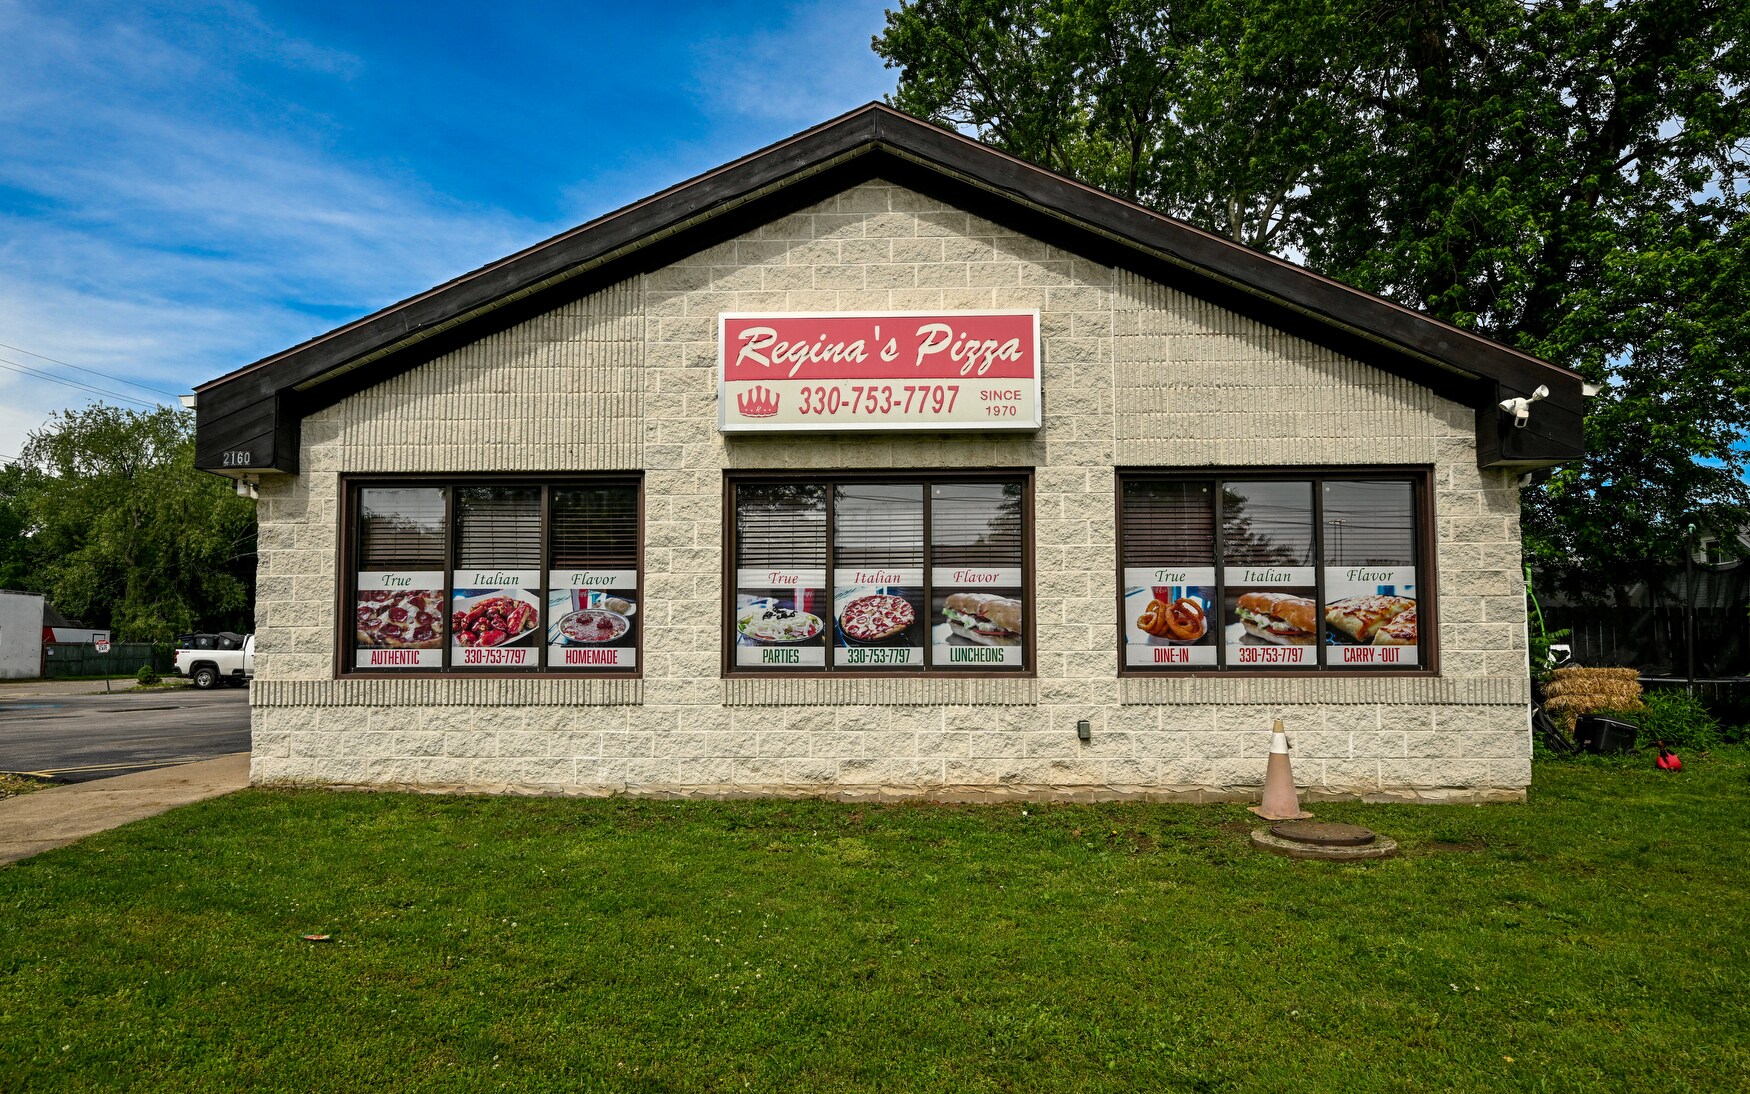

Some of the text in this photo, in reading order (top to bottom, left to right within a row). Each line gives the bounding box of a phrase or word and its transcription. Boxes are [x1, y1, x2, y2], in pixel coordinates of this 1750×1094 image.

[735, 323, 1023, 377] Regina's Pizza
[798, 385, 960, 415] 330-753-7797
[980, 389, 1022, 401] SINCE
[985, 405, 1017, 416] 1970
[223, 452, 250, 465] 2160
[382, 572, 616, 587] True Italian Flavor
[768, 570, 1000, 584] True Italian Flavor
[1155, 568, 1394, 582] True Italian Flavor
[371, 650, 420, 665] AUTHENTIC
[464, 650, 526, 664] 330-753-7797
[565, 650, 618, 664] HOMEMADE
[762, 648, 799, 663] PARTIES
[847, 648, 910, 663] 330-753-7797
[950, 647, 1004, 662] LUNCHEONS
[1154, 648, 1189, 662] DINE-IN
[1239, 647, 1303, 662] 330-753-7797
[1343, 648, 1375, 662] CARRY
